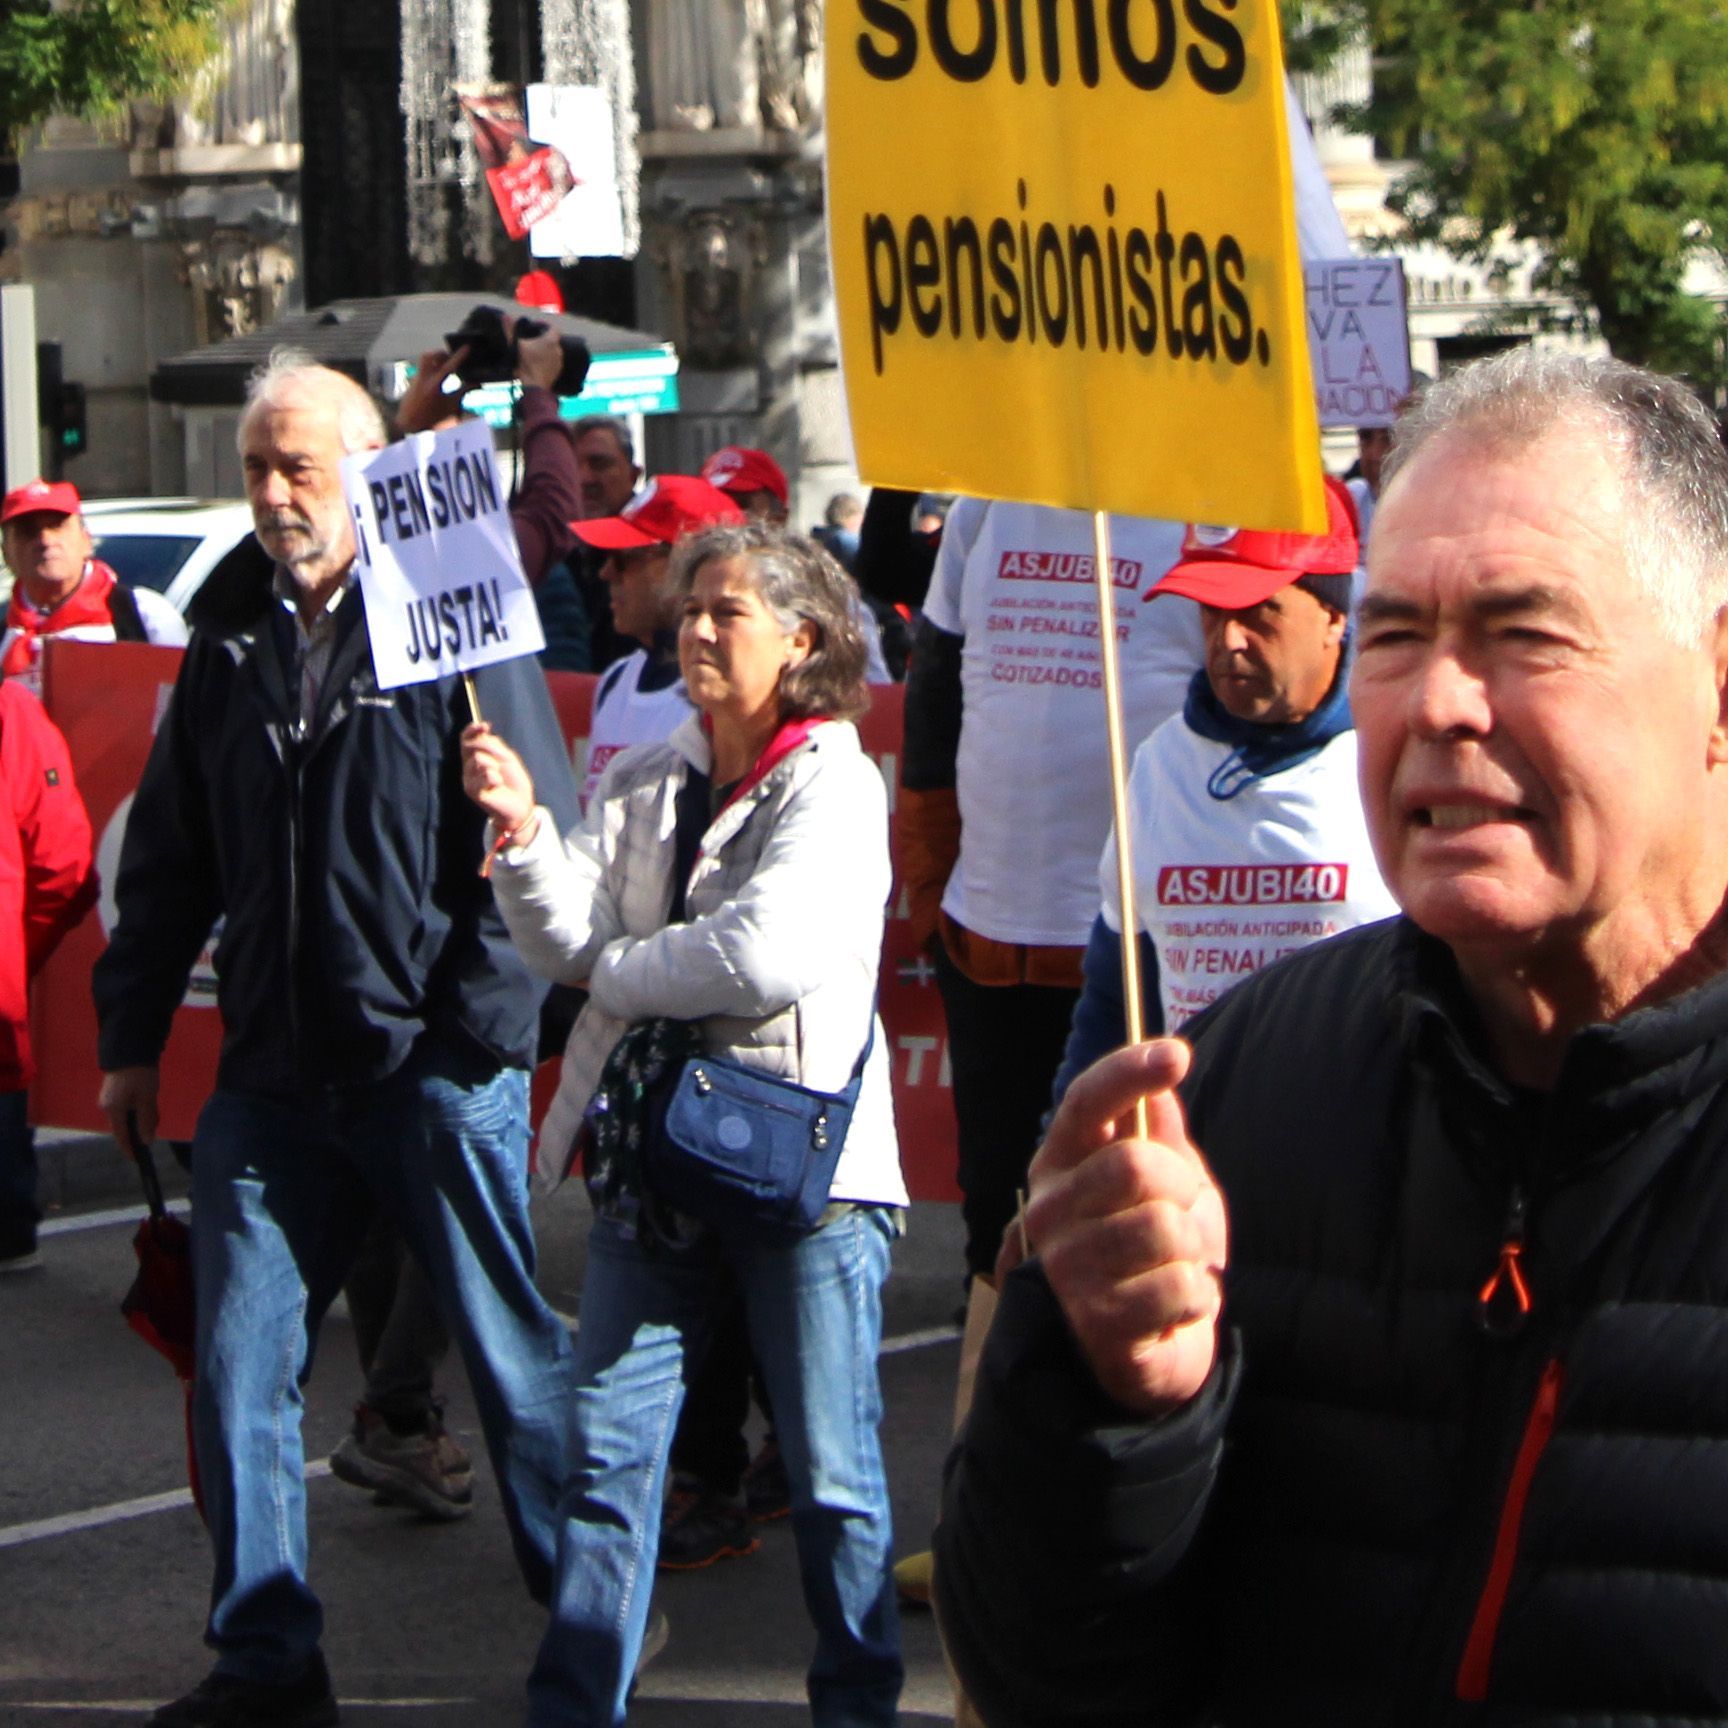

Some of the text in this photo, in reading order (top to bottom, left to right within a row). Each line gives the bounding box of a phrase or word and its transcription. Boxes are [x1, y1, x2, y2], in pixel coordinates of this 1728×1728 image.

[865, 180, 1270, 373] pensionistas.
[1310, 309, 1366, 342] VA
[1322, 343, 1382, 385] LA
[1002, 553, 1137, 587] ASJUB40
[405, 577, 508, 665] JUSTA!
[1020, 617, 1130, 642] PENALIZR
[1164, 866, 1341, 904] ASJUBI40
[1242, 921, 1337, 938] ANTICIPADA
